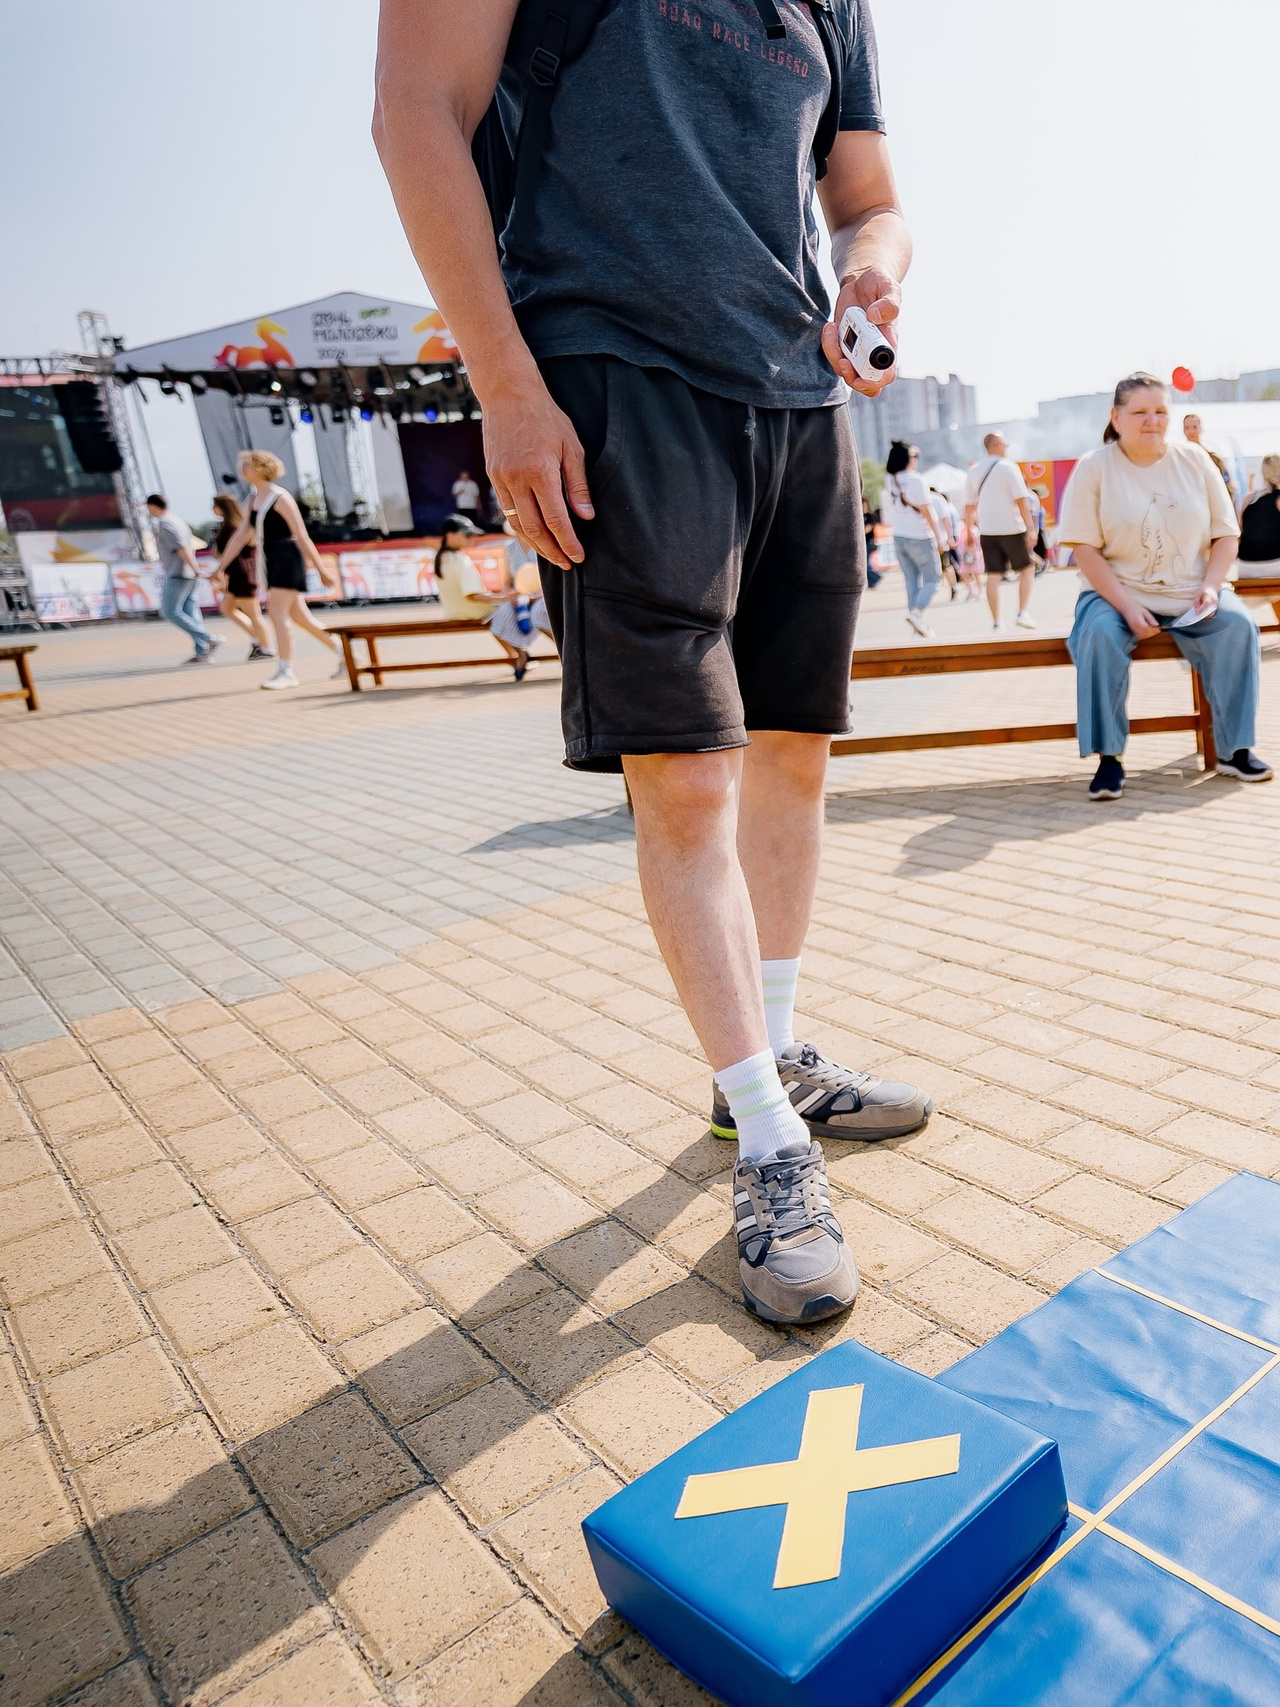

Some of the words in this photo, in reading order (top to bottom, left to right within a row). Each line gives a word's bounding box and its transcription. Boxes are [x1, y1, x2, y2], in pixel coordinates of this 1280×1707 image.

[659, 0, 702, 31] ROAD
[713, 21, 750, 52] RACE
[760, 43, 809, 78] LEGEND
